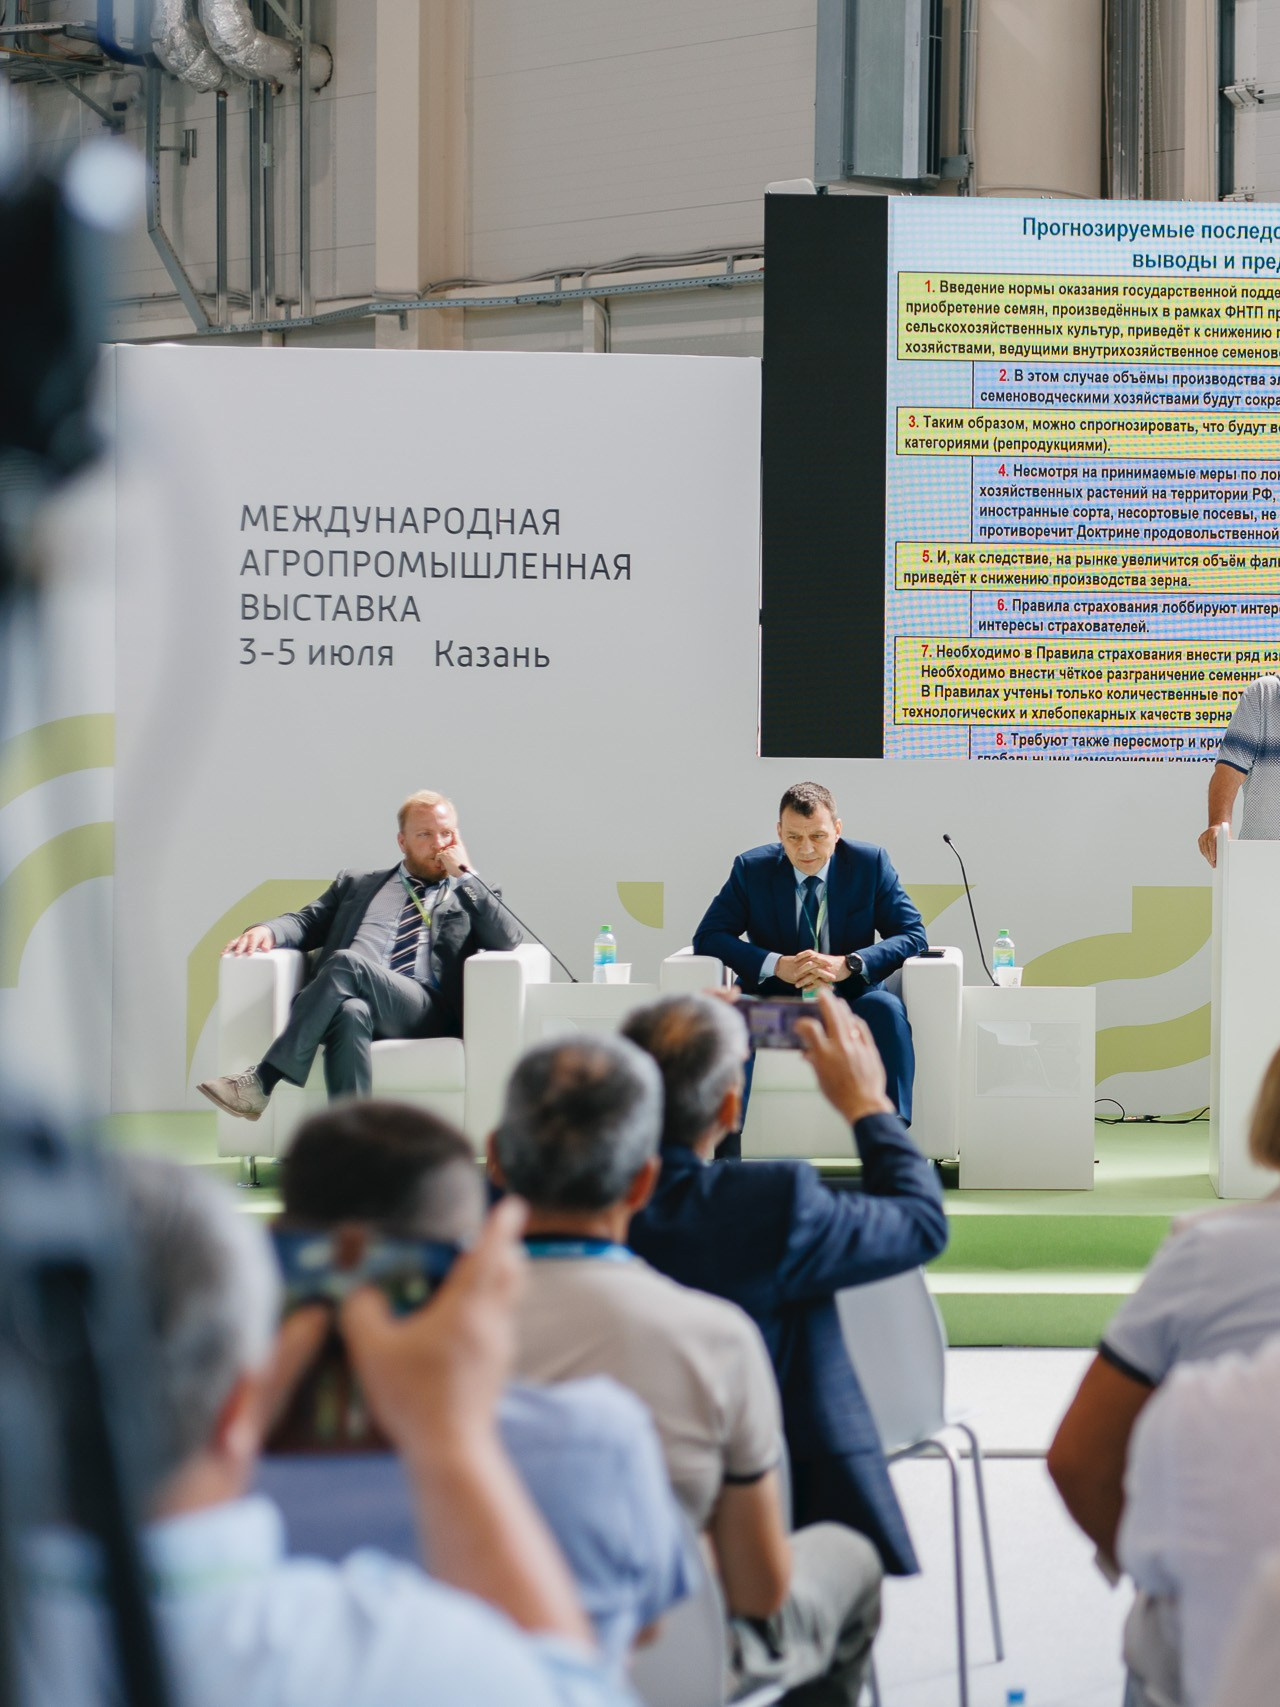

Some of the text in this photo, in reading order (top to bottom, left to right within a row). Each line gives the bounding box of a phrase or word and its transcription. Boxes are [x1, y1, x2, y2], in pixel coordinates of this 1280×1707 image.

[1022, 217, 1195, 242] Прогнозируемые
[1132, 253, 1217, 272] выводы
[1223, 254, 1235, 270] и
[924, 279, 936, 293] 1.
[939, 279, 1005, 295] Введение
[1008, 283, 1055, 297] нормы
[1058, 284, 1119, 296] оказания
[1122, 285, 1238, 299] государственной
[905, 300, 1000, 316] приобретение
[1003, 303, 1048, 317] семян,
[1051, 303, 1159, 318] произведённых
[1174, 306, 1221, 320] рамках
[1224, 304, 1264, 319] ФНТП
[904, 321, 1063, 335] сельскохозяйственных
[1066, 324, 1124, 339] культур,
[1127, 324, 1191, 339] приведёт
[1203, 327, 1272, 339] снижению
[904, 340, 995, 356] хозяйствами,
[998, 344, 1069, 358] ведущими
[1072, 344, 1219, 359] внутрихозяйственное
[998, 368, 1010, 382] 2.
[1026, 371, 1060, 383] этом
[1062, 372, 1110, 386] случае
[1112, 370, 1168, 384] объёмы
[1171, 373, 1266, 388] производства
[979, 391, 1110, 405] семеноводческими
[1112, 391, 1200, 405] хозяйствами
[1202, 391, 1242, 409] будут
[908, 414, 920, 428] 3.
[922, 414, 964, 429] Таким
[967, 415, 1028, 432] образом,
[1032, 419, 1076, 431] можно
[1078, 420, 1199, 435] спрогнозировать,
[1227, 419, 1267, 436] будут
[904, 437, 1111, 454] категориями (репродукциями).
[997, 463, 1010, 477] 4.
[1012, 463, 1078, 481] Несмотря
[1100, 467, 1199, 481] принимаемые
[1201, 468, 1237, 483] меры
[978, 484, 1084, 498] хозяйственных
[1086, 485, 1148, 501] растений
[1169, 488, 1249, 503] территории
[1251, 486, 1276, 503] РФ,
[239, 504, 561, 540] МЕЖДУНАРОДНАЯ
[978, 506, 1070, 520] иностранные
[1072, 507, 1117, 521] сорта,
[1116, 507, 1200, 522] несортовые
[1202, 508, 1258, 523] посевы,
[978, 525, 1074, 540] противоречит
[1075, 523, 1141, 541] Доктрине
[1142, 527, 1280, 541] продовольственной
[239, 549, 632, 580] АГРОПРОМЫШЛЕННАЯ
[921, 549, 933, 563] 5.
[936, 549, 950, 566] И,
[954, 552, 976, 564] как
[978, 553, 1052, 567] следствие,
[1074, 554, 1118, 568] рынке
[1120, 555, 1199, 568] увеличится
[1202, 553, 1246, 568] объём
[902, 570, 1192, 589] приведёт снижению производства зерна.
[240, 593, 422, 622] ВЫСТАВКА
[996, 597, 1008, 612] 6.
[1011, 597, 1070, 615] Правила
[1072, 601, 1159, 615] страхования
[1160, 599, 1240, 617] лоббируют
[978, 619, 1150, 634] интересы страхователей.
[307, 643, 394, 666] июля
[434, 639, 551, 668] Казань
[920, 644, 933, 658] 7.
[935, 644, 1021, 661] Необходимо
[1036, 645, 1094, 662] Правила
[1096, 649, 1183, 663] страхования
[1185, 650, 1232, 662] внести
[1234, 650, 1261, 664] ряд
[920, 664, 1006, 680] Необходимо
[1009, 668, 1055, 679] внести
[1059, 666, 1103, 680] чёткое
[1106, 669, 1204, 683] разграничение
[934, 684, 1000, 701] Правилах
[1002, 687, 1053, 702] учтены
[1055, 688, 1103, 700] только
[1106, 689, 1219, 701] количественные
[901, 706, 1233, 723] технологических хлебопекарных качеств зерна
[995, 732, 1007, 746] 8.
[1010, 732, 1069, 749] Требуют
[1070, 735, 1110, 747] также
[1112, 736, 1185, 751] пересмотр
